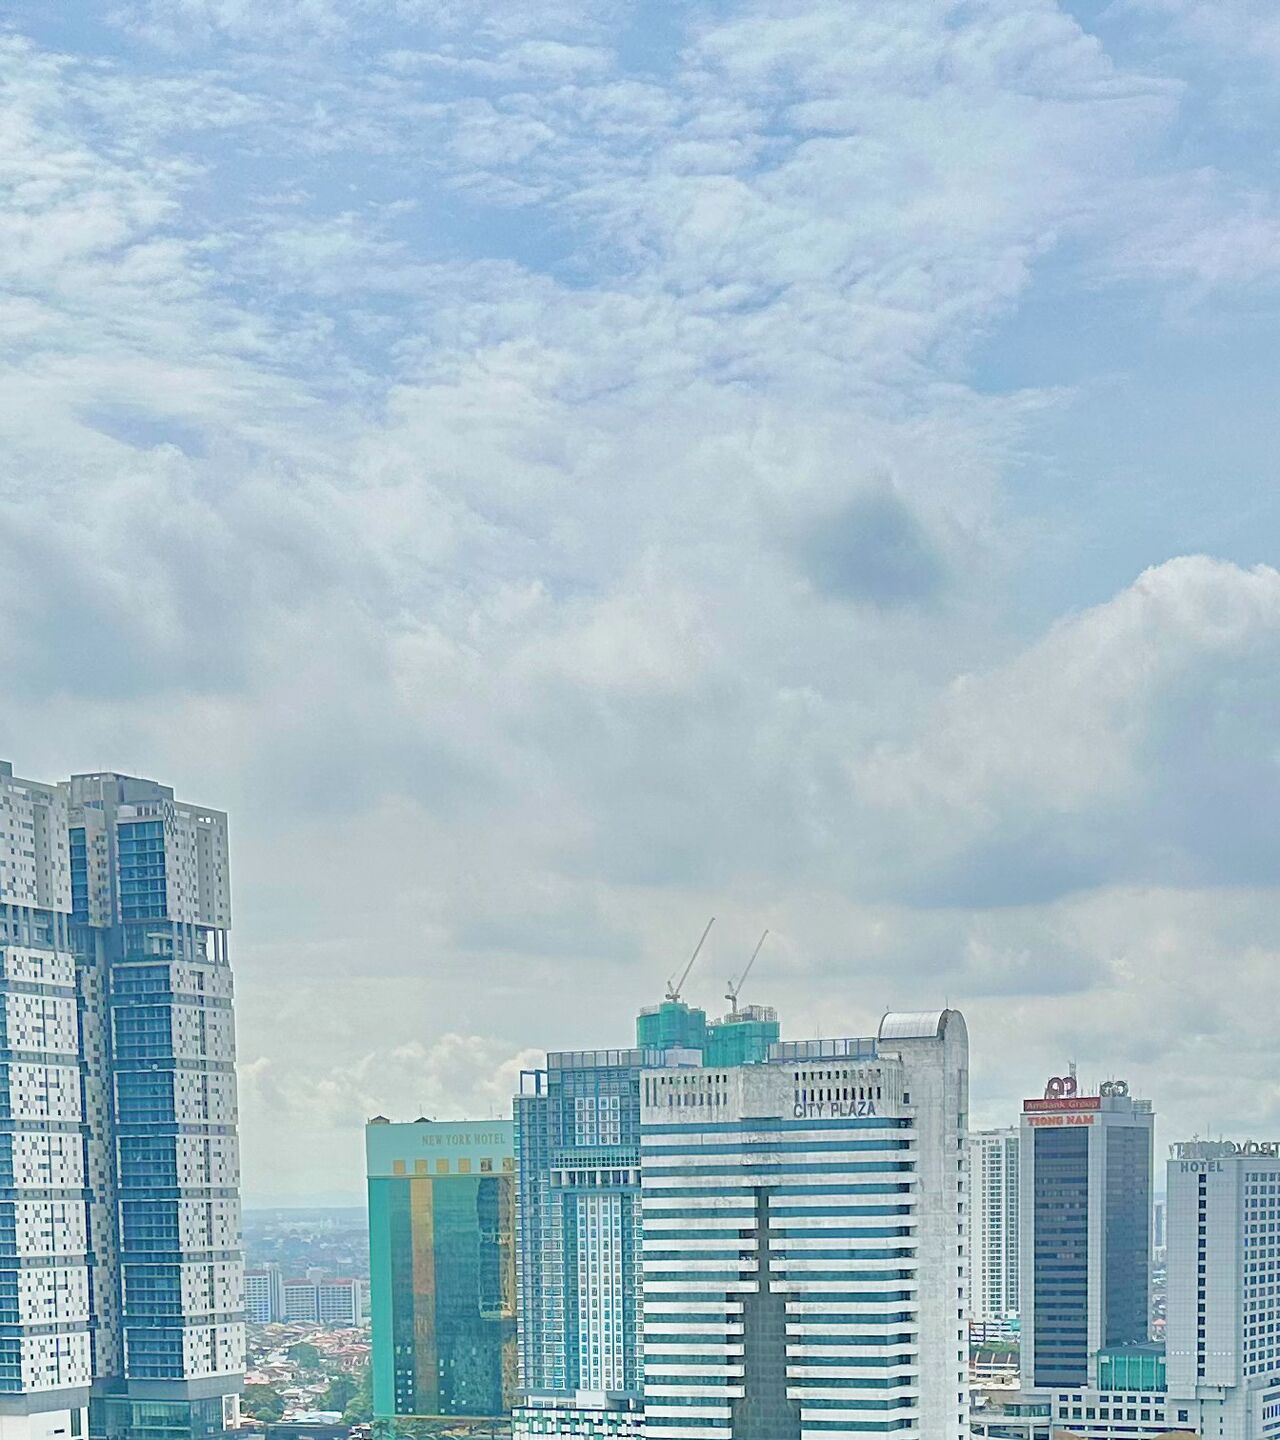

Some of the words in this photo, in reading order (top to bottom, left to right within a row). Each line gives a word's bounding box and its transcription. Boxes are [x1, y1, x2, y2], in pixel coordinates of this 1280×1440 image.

[793, 1102, 824, 1118] CITY
[830, 1101, 876, 1117] PLAZA
[1026, 1101, 1064, 1109] AmBank
[1068, 1099, 1098, 1109] Group
[1027, 1116, 1063, 1126] TIONG
[1066, 1115, 1094, 1125] NAM
[422, 1135, 442, 1146] NEW
[446, 1134, 472, 1145] YORK
[474, 1133, 506, 1145] HOTEL
[1180, 1162, 1224, 1173] HOTEL
